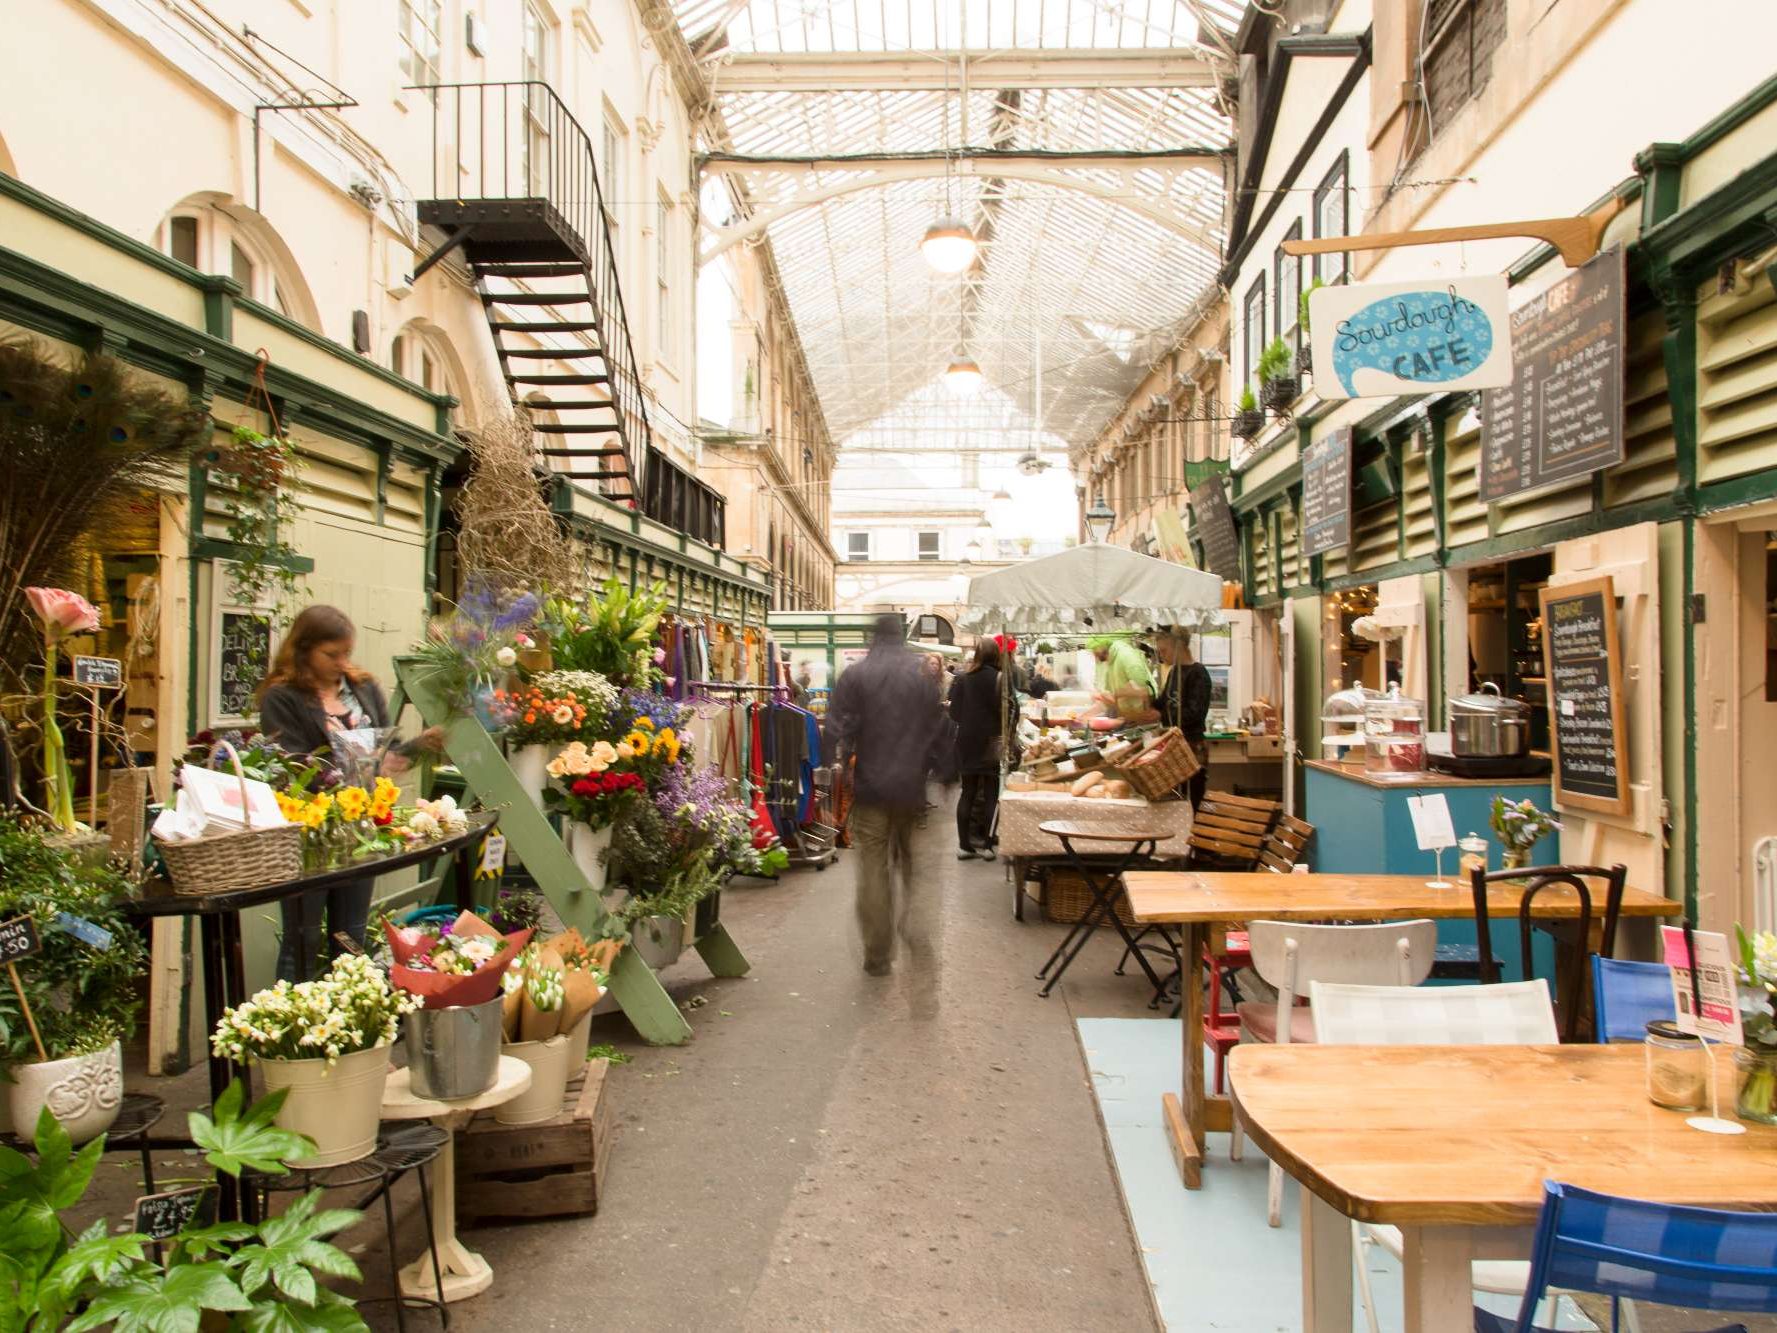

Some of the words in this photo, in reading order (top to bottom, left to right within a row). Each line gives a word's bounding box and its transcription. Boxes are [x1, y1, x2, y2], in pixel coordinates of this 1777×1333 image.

[1336, 284, 1475, 352] Sourdough
[1393, 338, 1471, 380] CAFE
[221, 633, 266, 650] DELIVR
